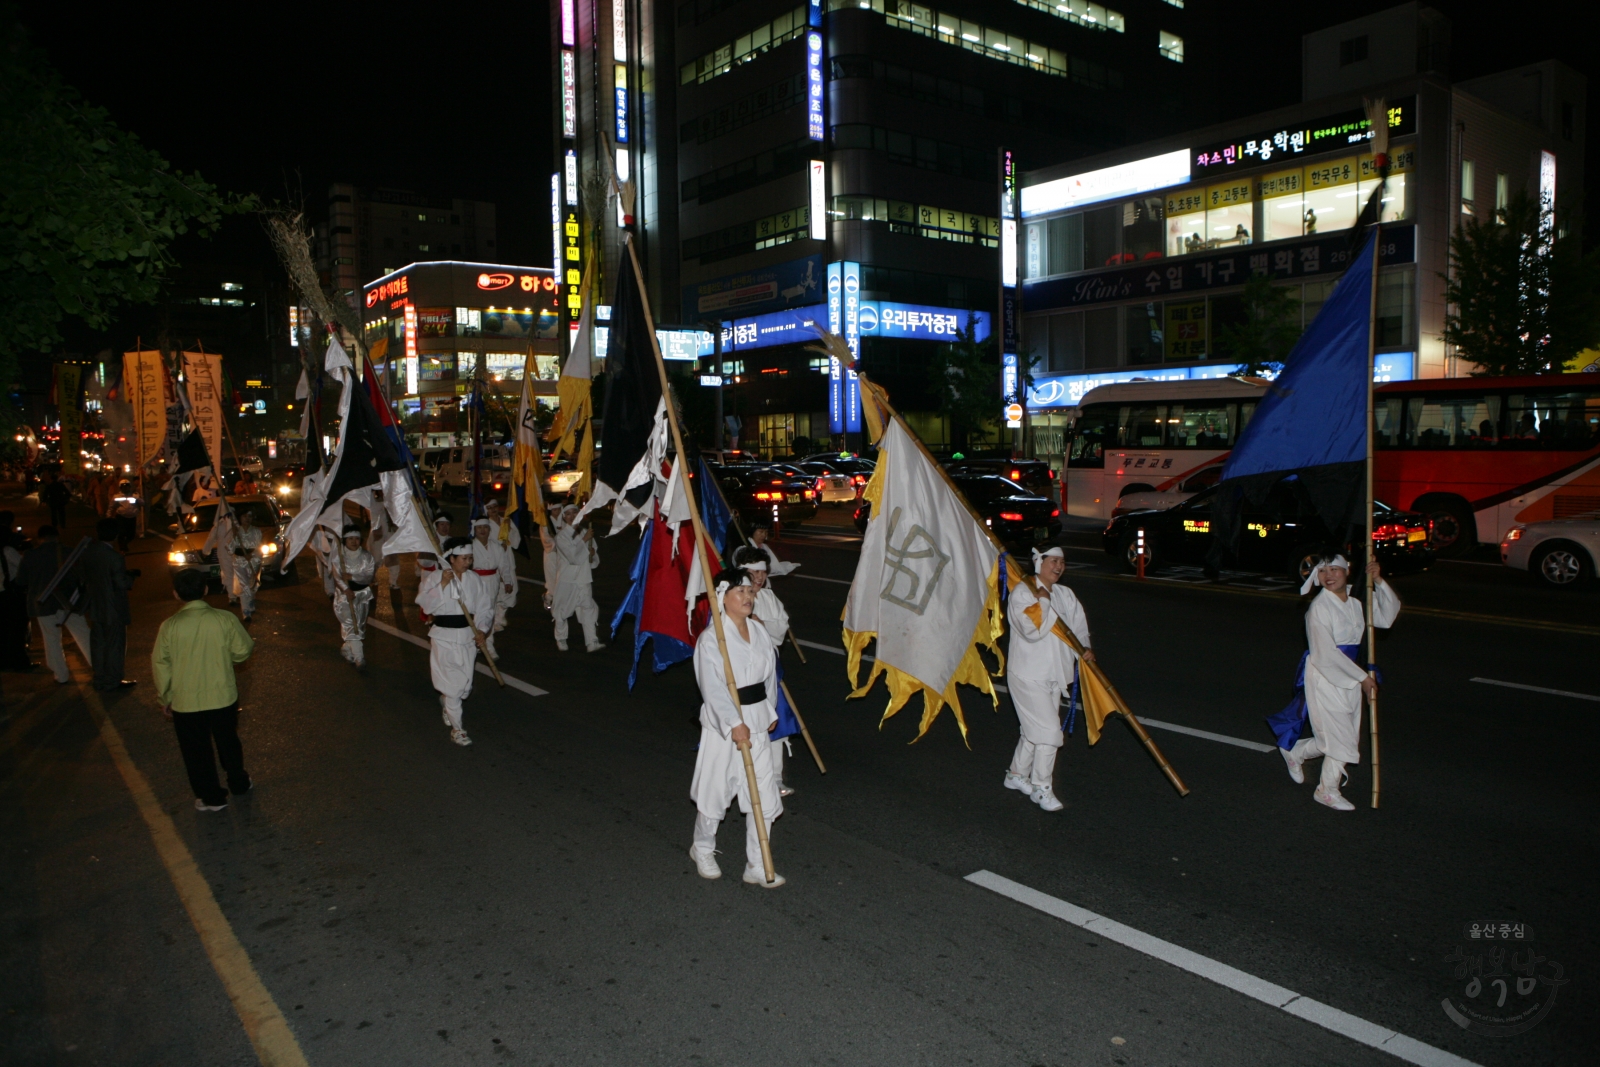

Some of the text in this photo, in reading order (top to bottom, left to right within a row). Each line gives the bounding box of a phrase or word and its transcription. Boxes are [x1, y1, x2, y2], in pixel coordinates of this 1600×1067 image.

[1197, 130, 1304, 166] 차소민 무용학원
[1311, 164, 1351, 185] 한국무용
[1072, 277, 1132, 302] Kim's
[1145, 265, 1183, 293] 수입
[1196, 254, 1236, 285] 가구
[1250, 245, 1320, 278] 백화점
[379, 276, 409, 301] 하이마트
[881, 308, 957, 335] 우리투자증권
